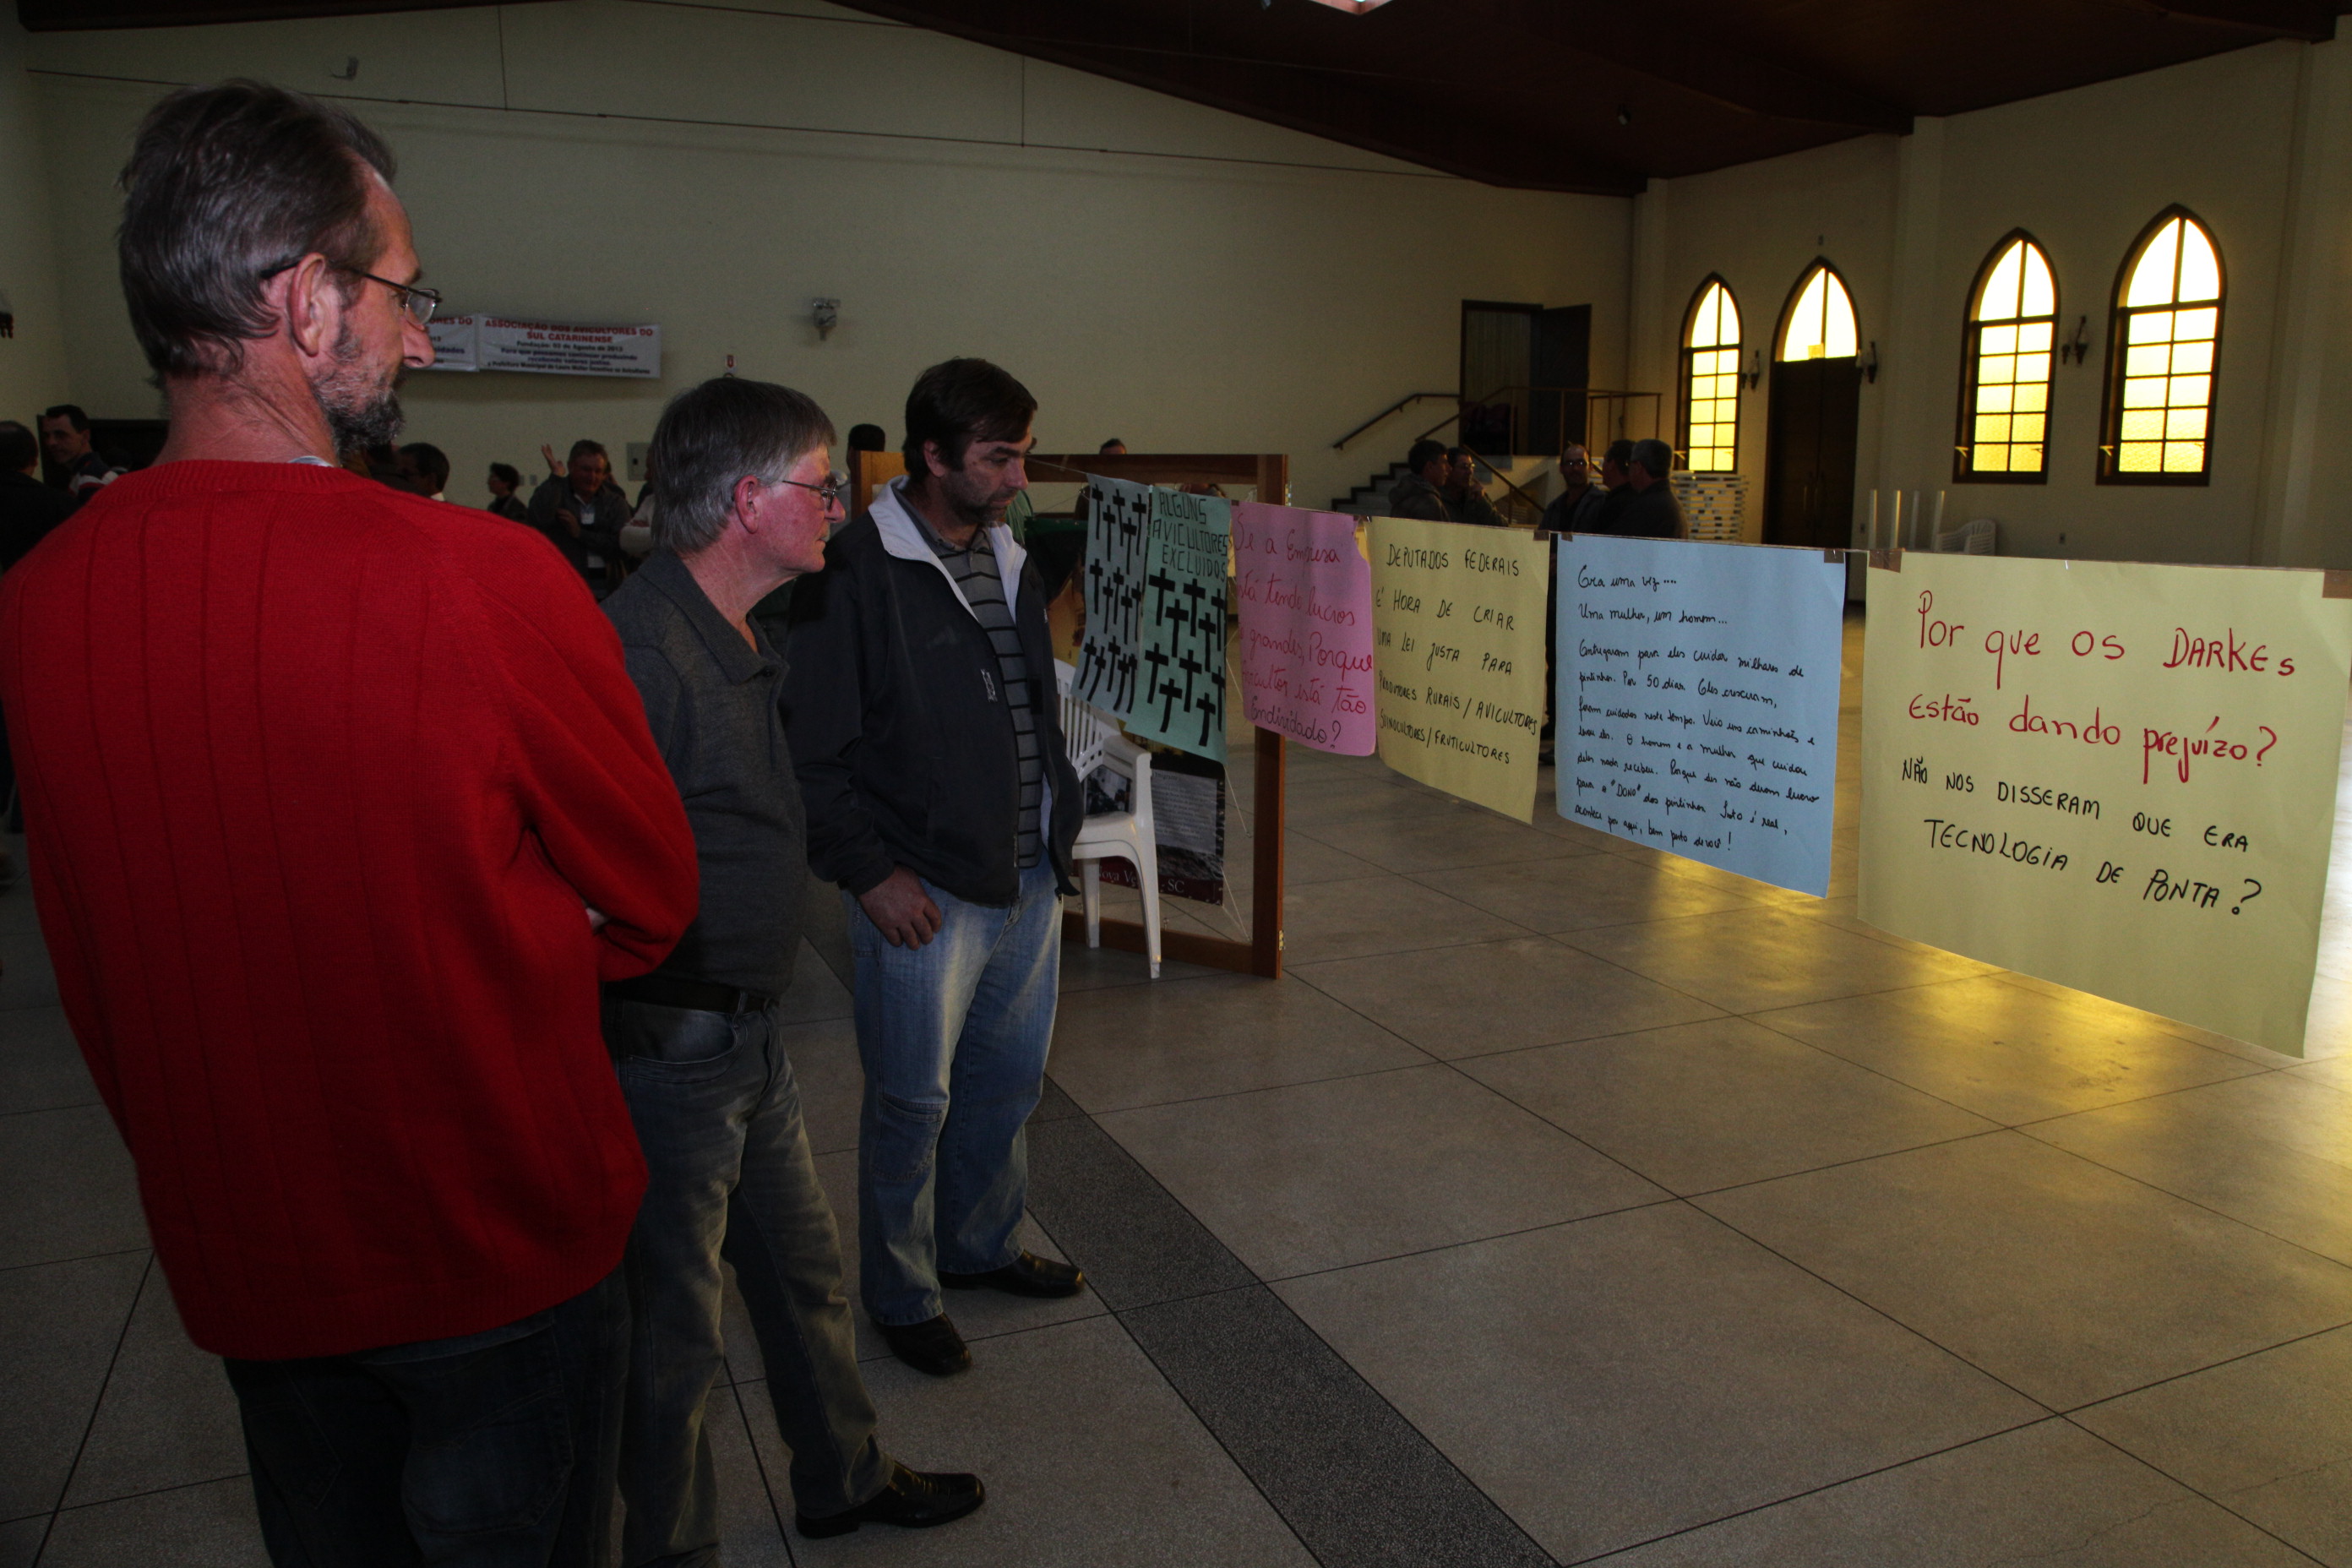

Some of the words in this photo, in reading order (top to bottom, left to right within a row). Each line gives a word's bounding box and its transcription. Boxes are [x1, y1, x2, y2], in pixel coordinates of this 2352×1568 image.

[486, 319, 547, 331] ASSOCIAÇÃO
[573, 326, 637, 335] AVICULTORES
[527, 331, 545, 340] SUL
[548, 333, 613, 343] CATARINENSE
[1159, 492, 1206, 525] ALGUNS
[1152, 519, 1228, 557] AVICULTORES
[1234, 513, 1253, 551] Se
[1266, 537, 1277, 554] a
[1162, 544, 1226, 582] EXCLUIDOS
[1386, 543, 1449, 569] DEPUTADOS
[1465, 549, 1519, 576] FEDERAIS
[1578, 564, 1605, 588] Era
[1610, 577, 1636, 587] uma
[1305, 585, 1355, 626] lucros
[1376, 586, 1384, 607] É
[1393, 590, 1420, 613] HORA
[1436, 599, 1453, 618] DE
[1473, 606, 1514, 630] CRIAR
[1579, 603, 1603, 620] Uma
[1653, 611, 1672, 623] um
[1309, 631, 1372, 682] Porque
[1377, 628, 1391, 647] UMA
[1402, 632, 1414, 651] LEI
[1426, 643, 1460, 672] JUSTA
[1481, 652, 1512, 675] PARA
[1918, 591, 1964, 649] Por
[1984, 629, 2041, 690] que
[1693, 649, 1728, 662] cuidar
[1788, 665, 1804, 677] de
[1647, 674, 1659, 688] 50
[1331, 685, 1366, 714] tão
[1425, 687, 1460, 710] RURAIS
[1476, 701, 1538, 736] AVICULTORES
[1703, 710, 1723, 727] Veio
[2009, 694, 2121, 745] dando
[1700, 743, 1735, 758] mulher
[1724, 777, 1741, 788] não
[1902, 756, 1928, 784] NÃO
[1946, 773, 1974, 792] NOS
[1997, 781, 2101, 819] DISSERAM
[2132, 813, 2172, 837] QUE
[2203, 825, 2249, 852] ERA
[1924, 819, 2069, 871] TECNOLOGIA
[2096, 861, 2124, 884] DE
[1168, 879, 1184, 893] SC
